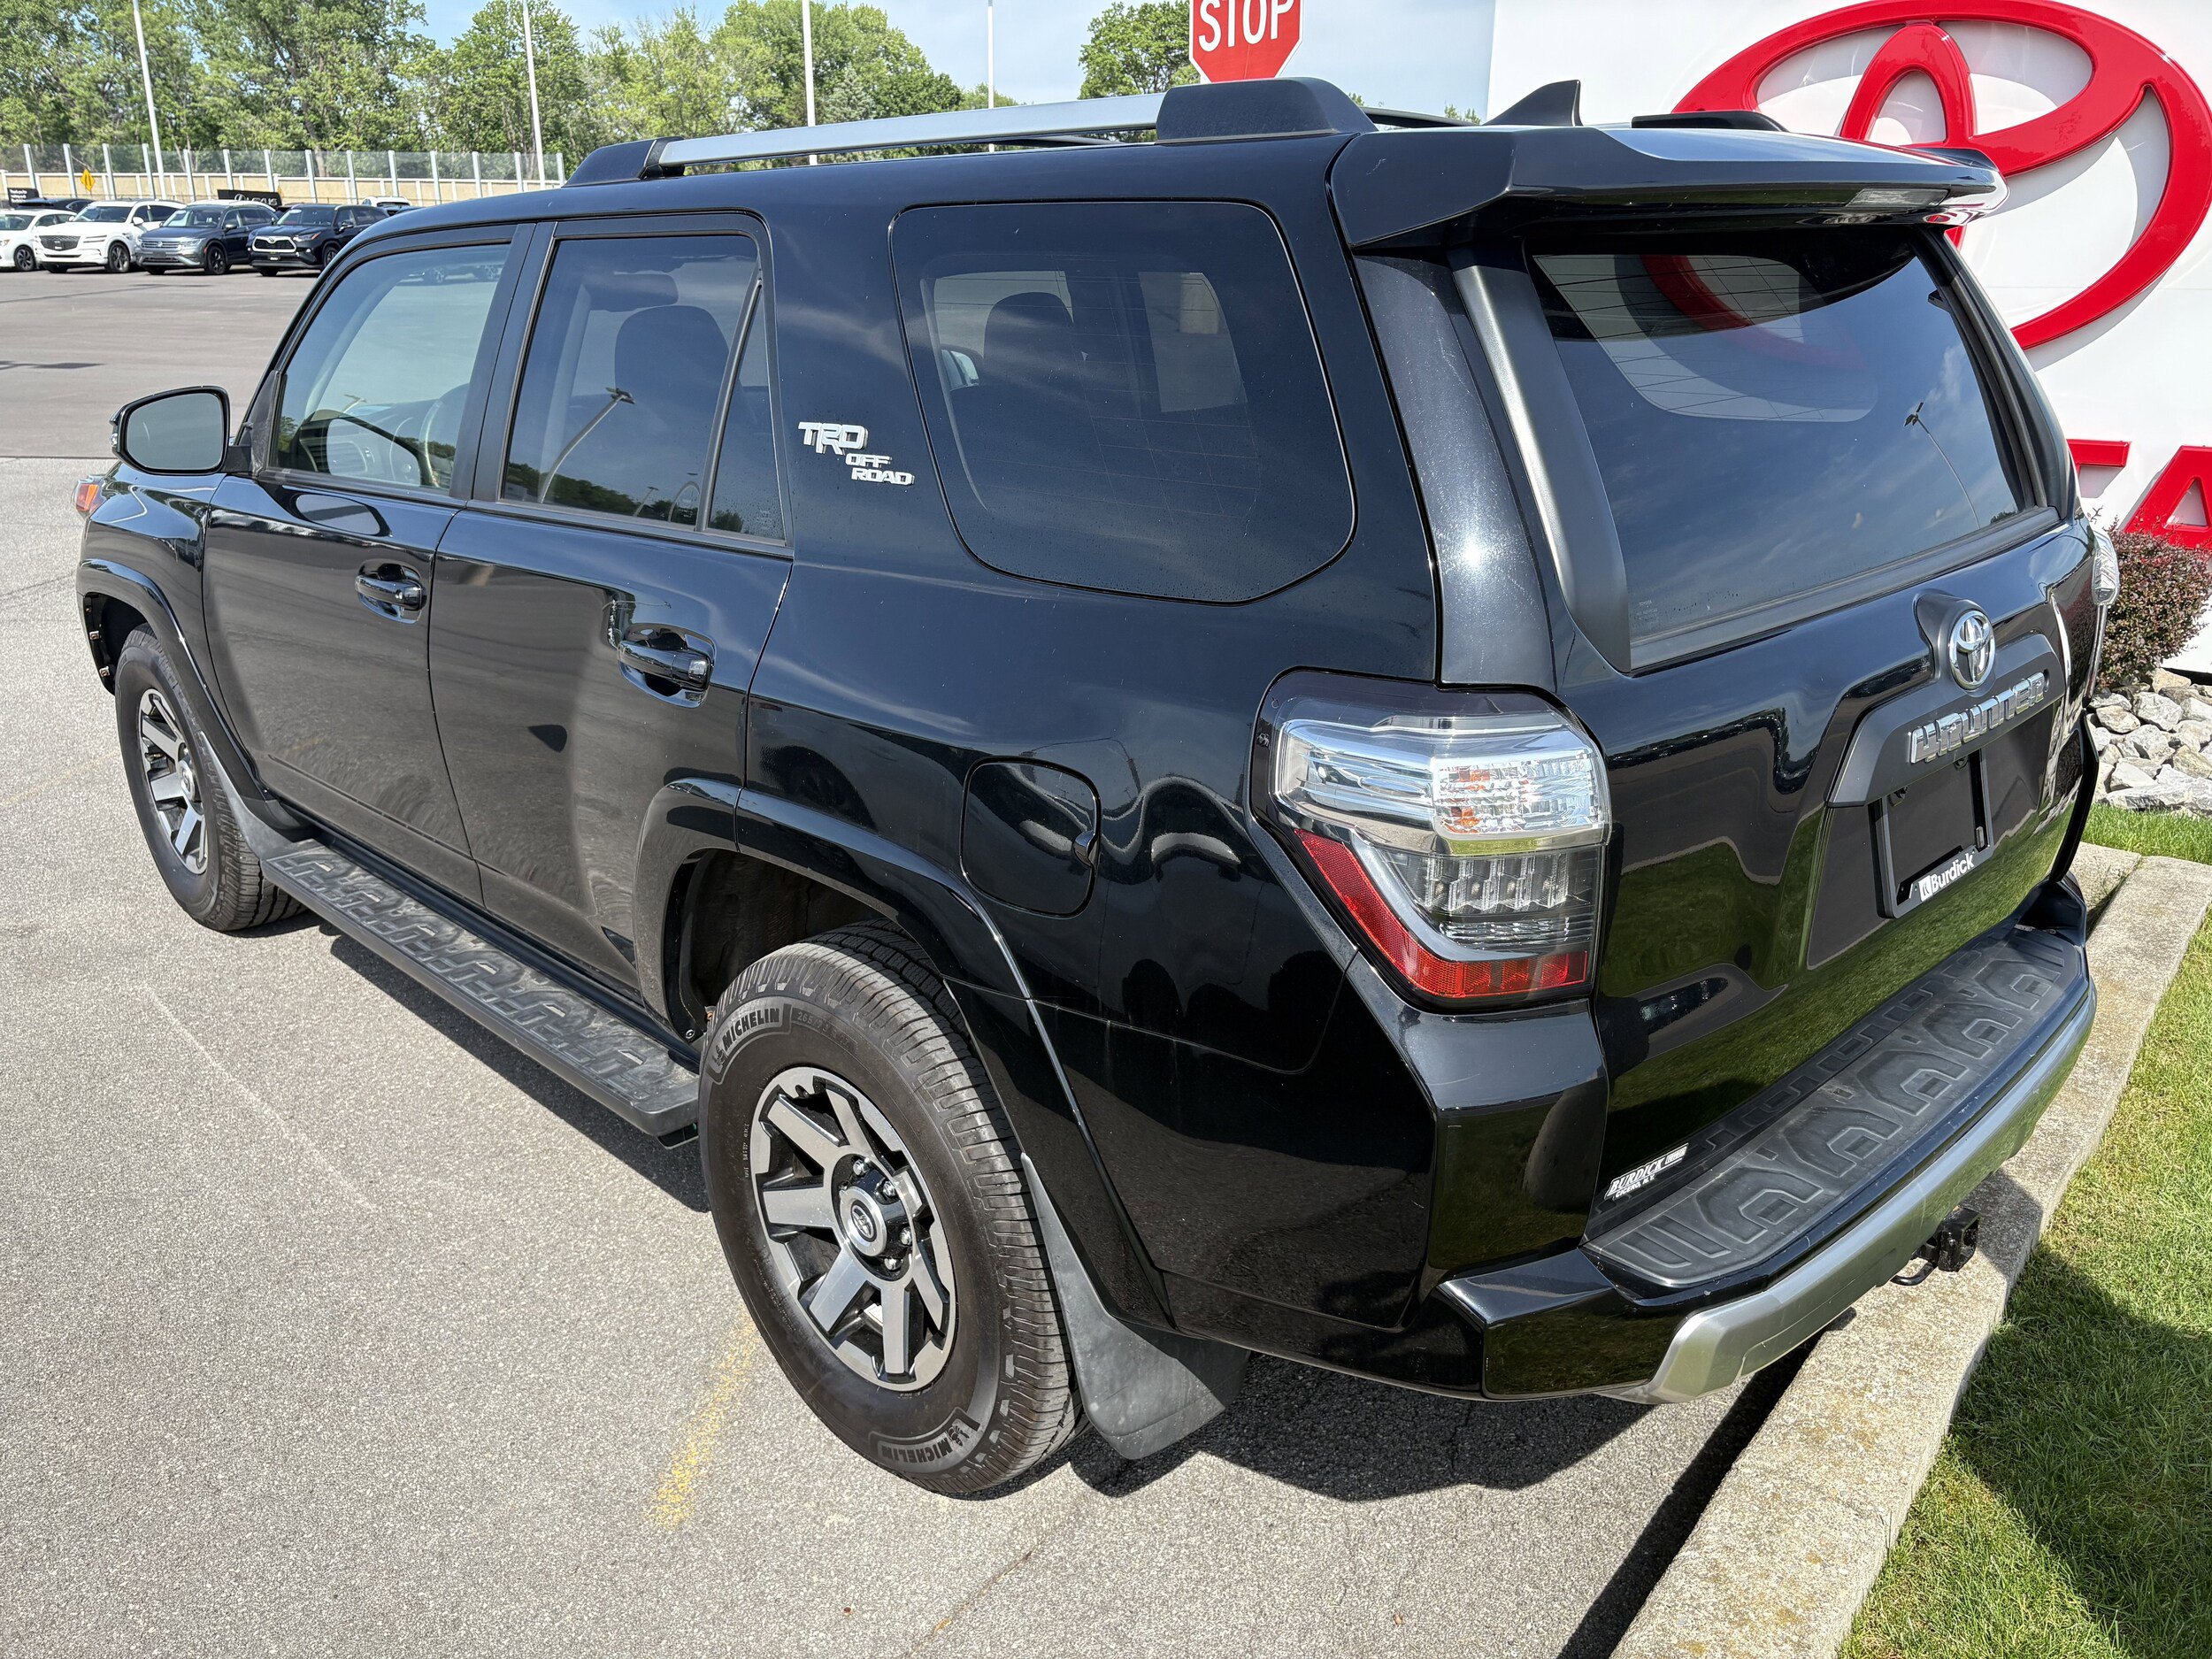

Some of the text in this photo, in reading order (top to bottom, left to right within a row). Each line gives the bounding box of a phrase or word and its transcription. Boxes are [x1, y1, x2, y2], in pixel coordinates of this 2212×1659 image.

[1199, 0, 1294, 51] STOP
[798, 421, 867, 455] TRD
[846, 453, 892, 468] OFF
[851, 467, 914, 485] ROAD
[1930, 852, 1975, 894] Burdick
[721, 1008, 780, 1051] MICHELIN
[1609, 1156, 1666, 1194] BURDICK
[881, 1437, 954, 1463] MICHELIN
